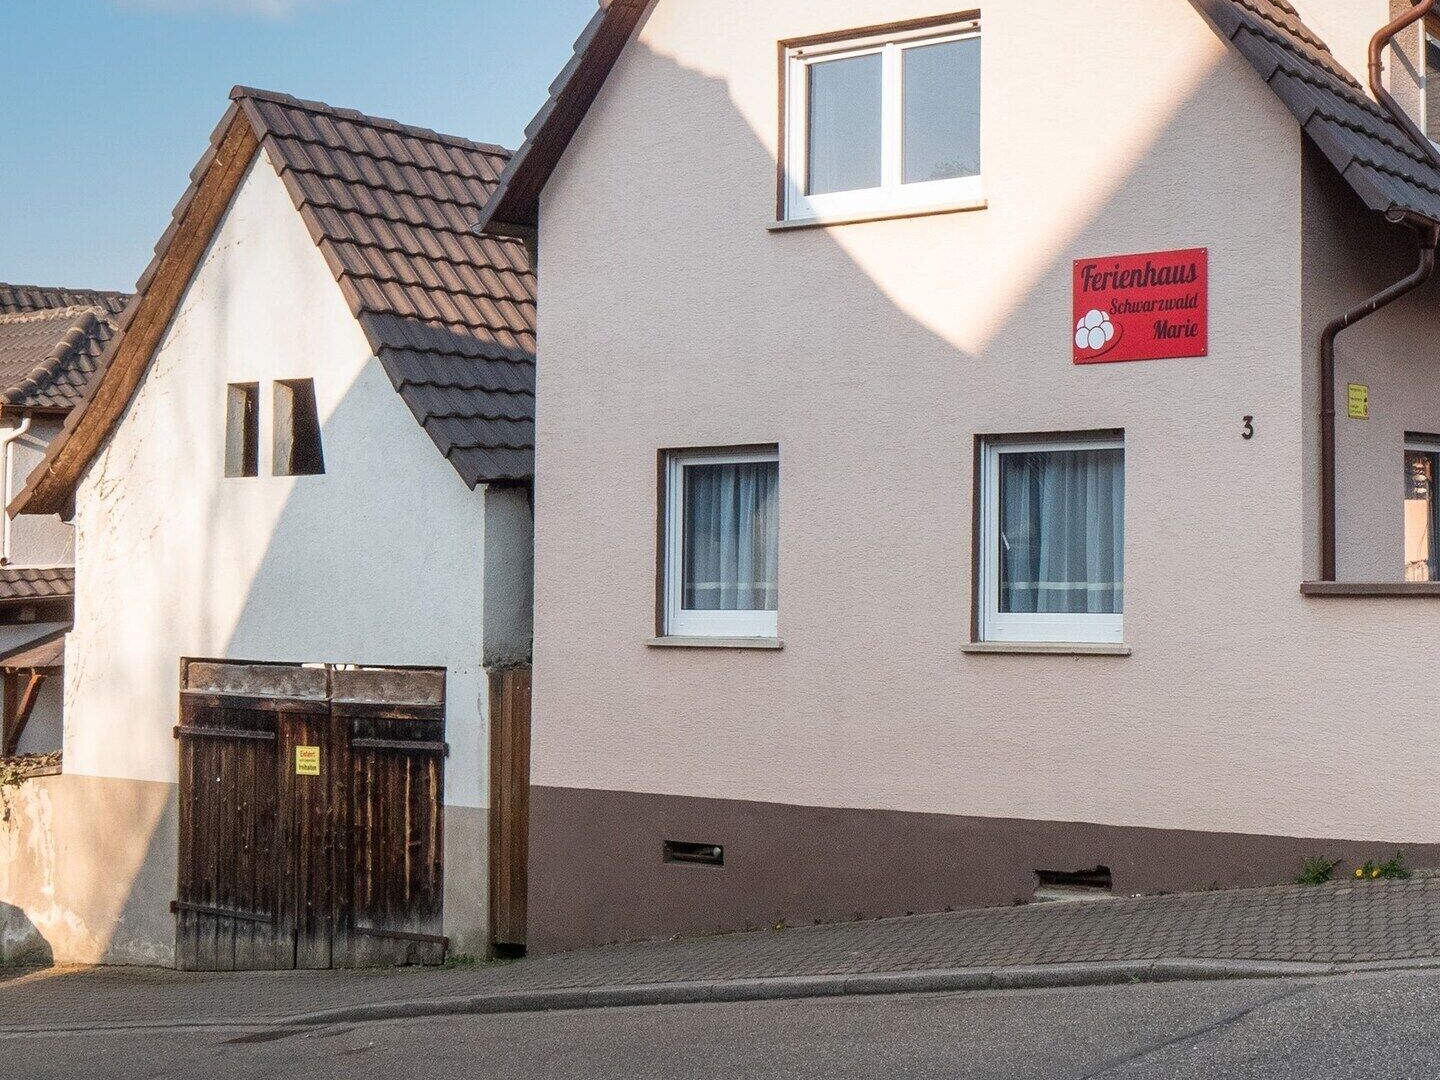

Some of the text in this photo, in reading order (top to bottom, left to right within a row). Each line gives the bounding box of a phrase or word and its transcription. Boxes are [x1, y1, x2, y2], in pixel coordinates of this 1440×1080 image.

[1081, 261, 1199, 292] Ferienhaus
[1109, 292, 1199, 315] Schwarzwald
[1153, 319, 1199, 340] Marie
[1241, 415, 1254, 440] 3
